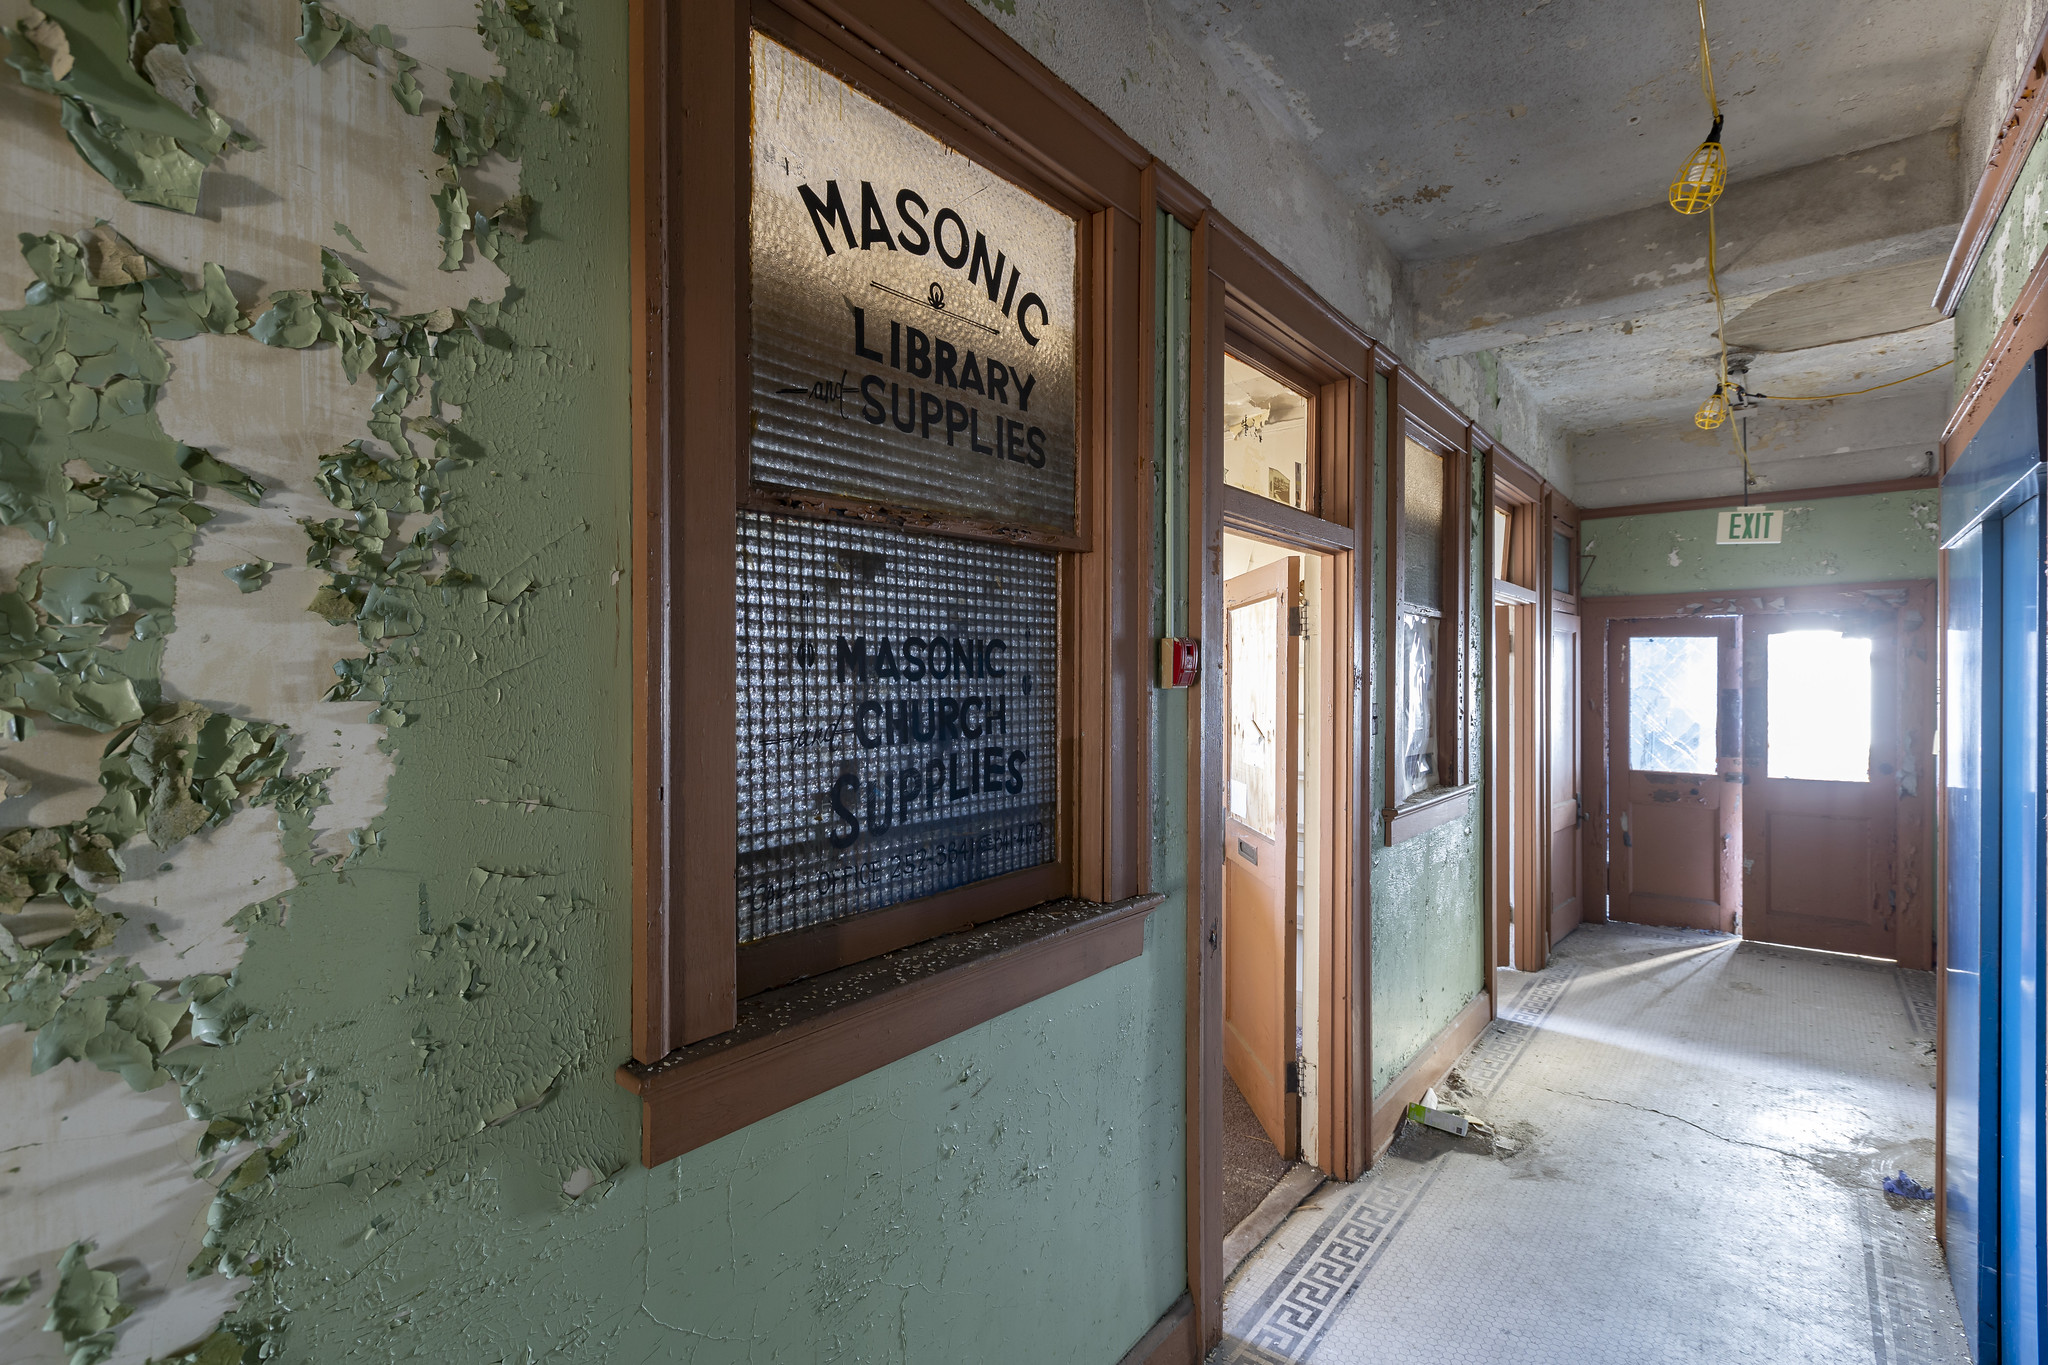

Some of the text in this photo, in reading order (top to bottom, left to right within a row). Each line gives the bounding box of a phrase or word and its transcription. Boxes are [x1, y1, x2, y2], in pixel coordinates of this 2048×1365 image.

[797, 180, 1050, 347] MASONIC
[854, 306, 1037, 412] LIBRARY
[808, 369, 1047, 469] and SUPPLIES
[1728, 512, 1774, 539] EXIT
[836, 636, 1007, 683] MASONIC
[793, 695, 1007, 751] and CHURCH
[829, 746, 1027, 849] SUPPLIES
[817, 860, 881, 895] OFFICE
